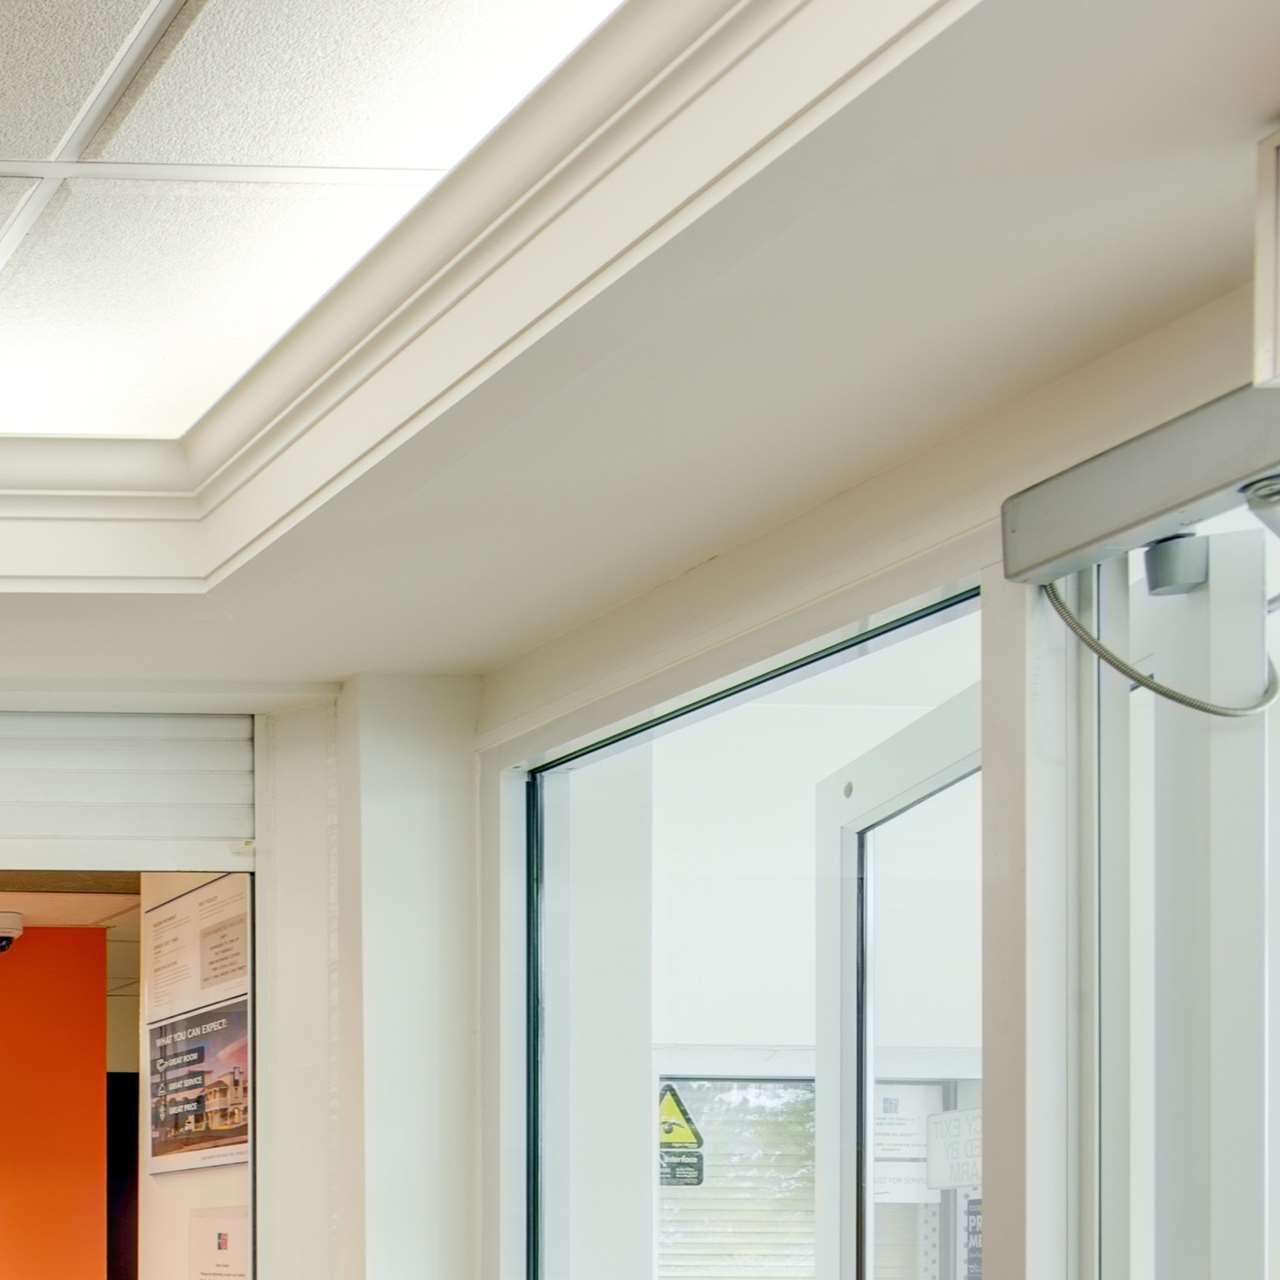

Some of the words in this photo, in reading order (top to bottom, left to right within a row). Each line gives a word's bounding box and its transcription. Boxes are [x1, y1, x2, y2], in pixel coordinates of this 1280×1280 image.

[155, 1034, 172, 1047] WHAT
[173, 1030, 186, 1041] YOU
[187, 1026, 201, 1038] CAN
[183, 1076, 202, 1087] SERVICE
